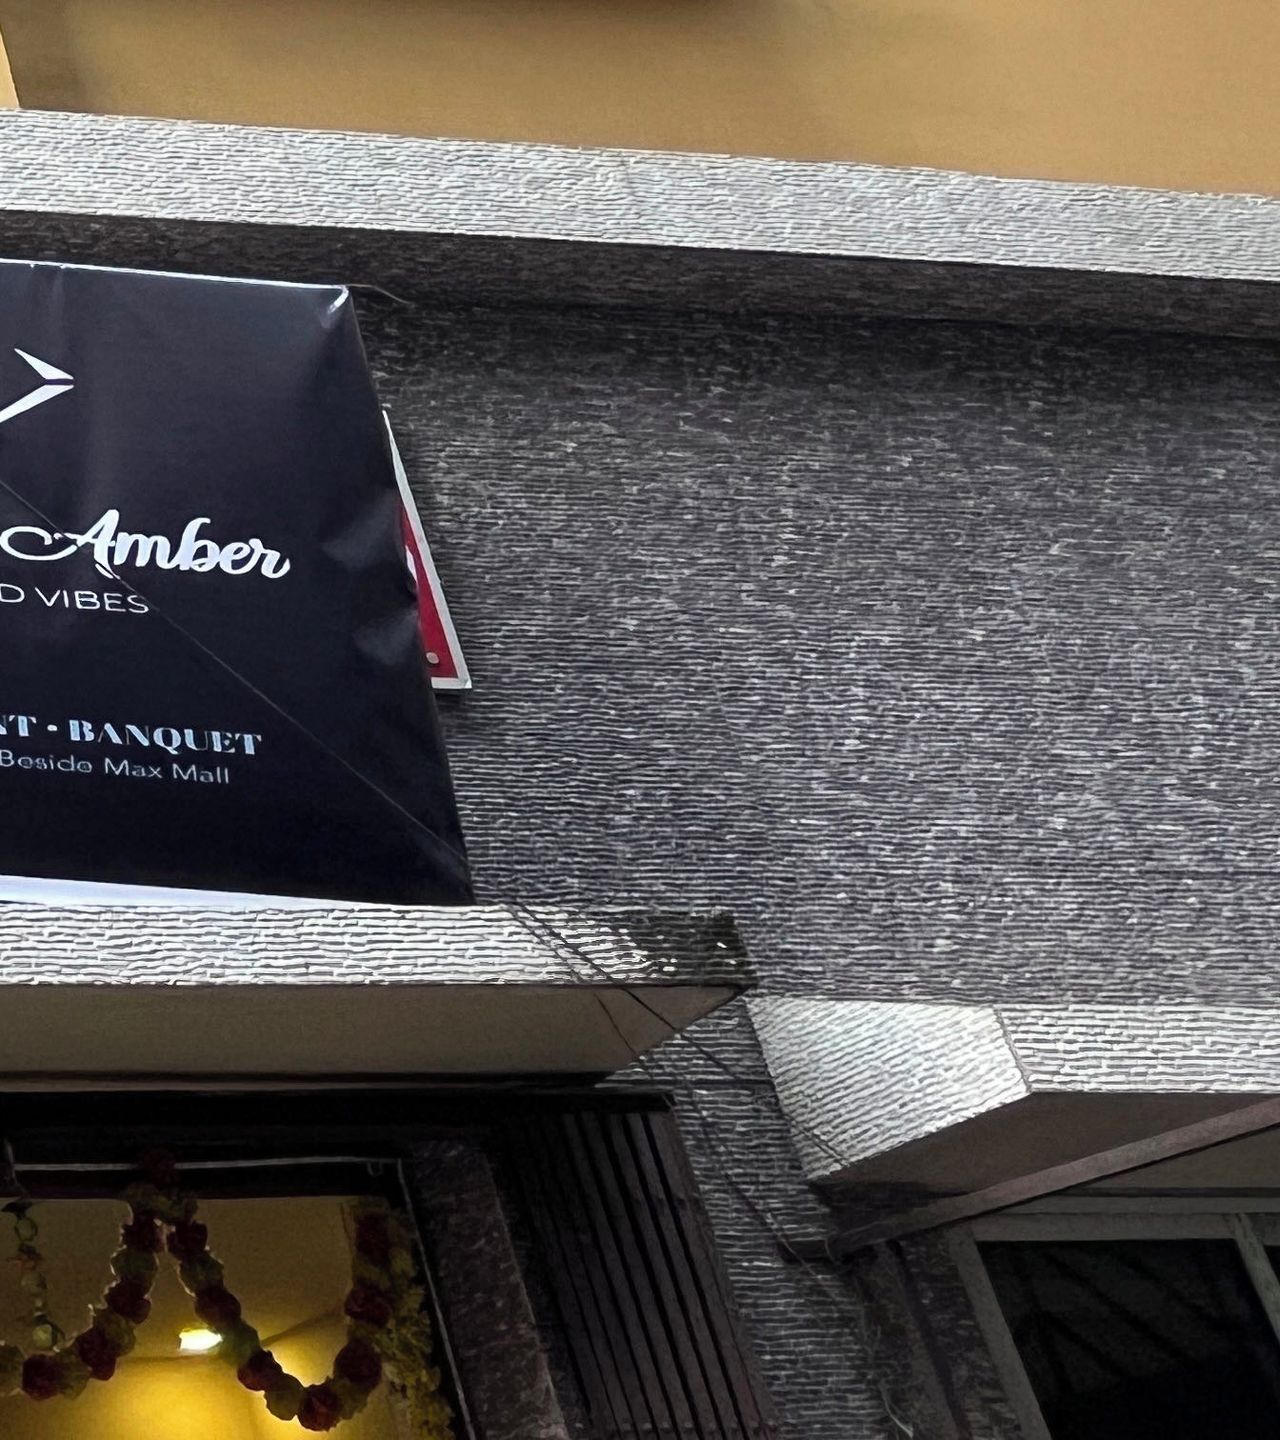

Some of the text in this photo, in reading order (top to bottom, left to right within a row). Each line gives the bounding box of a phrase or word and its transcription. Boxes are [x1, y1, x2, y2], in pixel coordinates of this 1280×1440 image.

[34, 586, 150, 614] VIBES
[68, 719, 263, 756] BANQUET
[104, 757, 163, 779] Max
[172, 763, 230, 785] Mall
